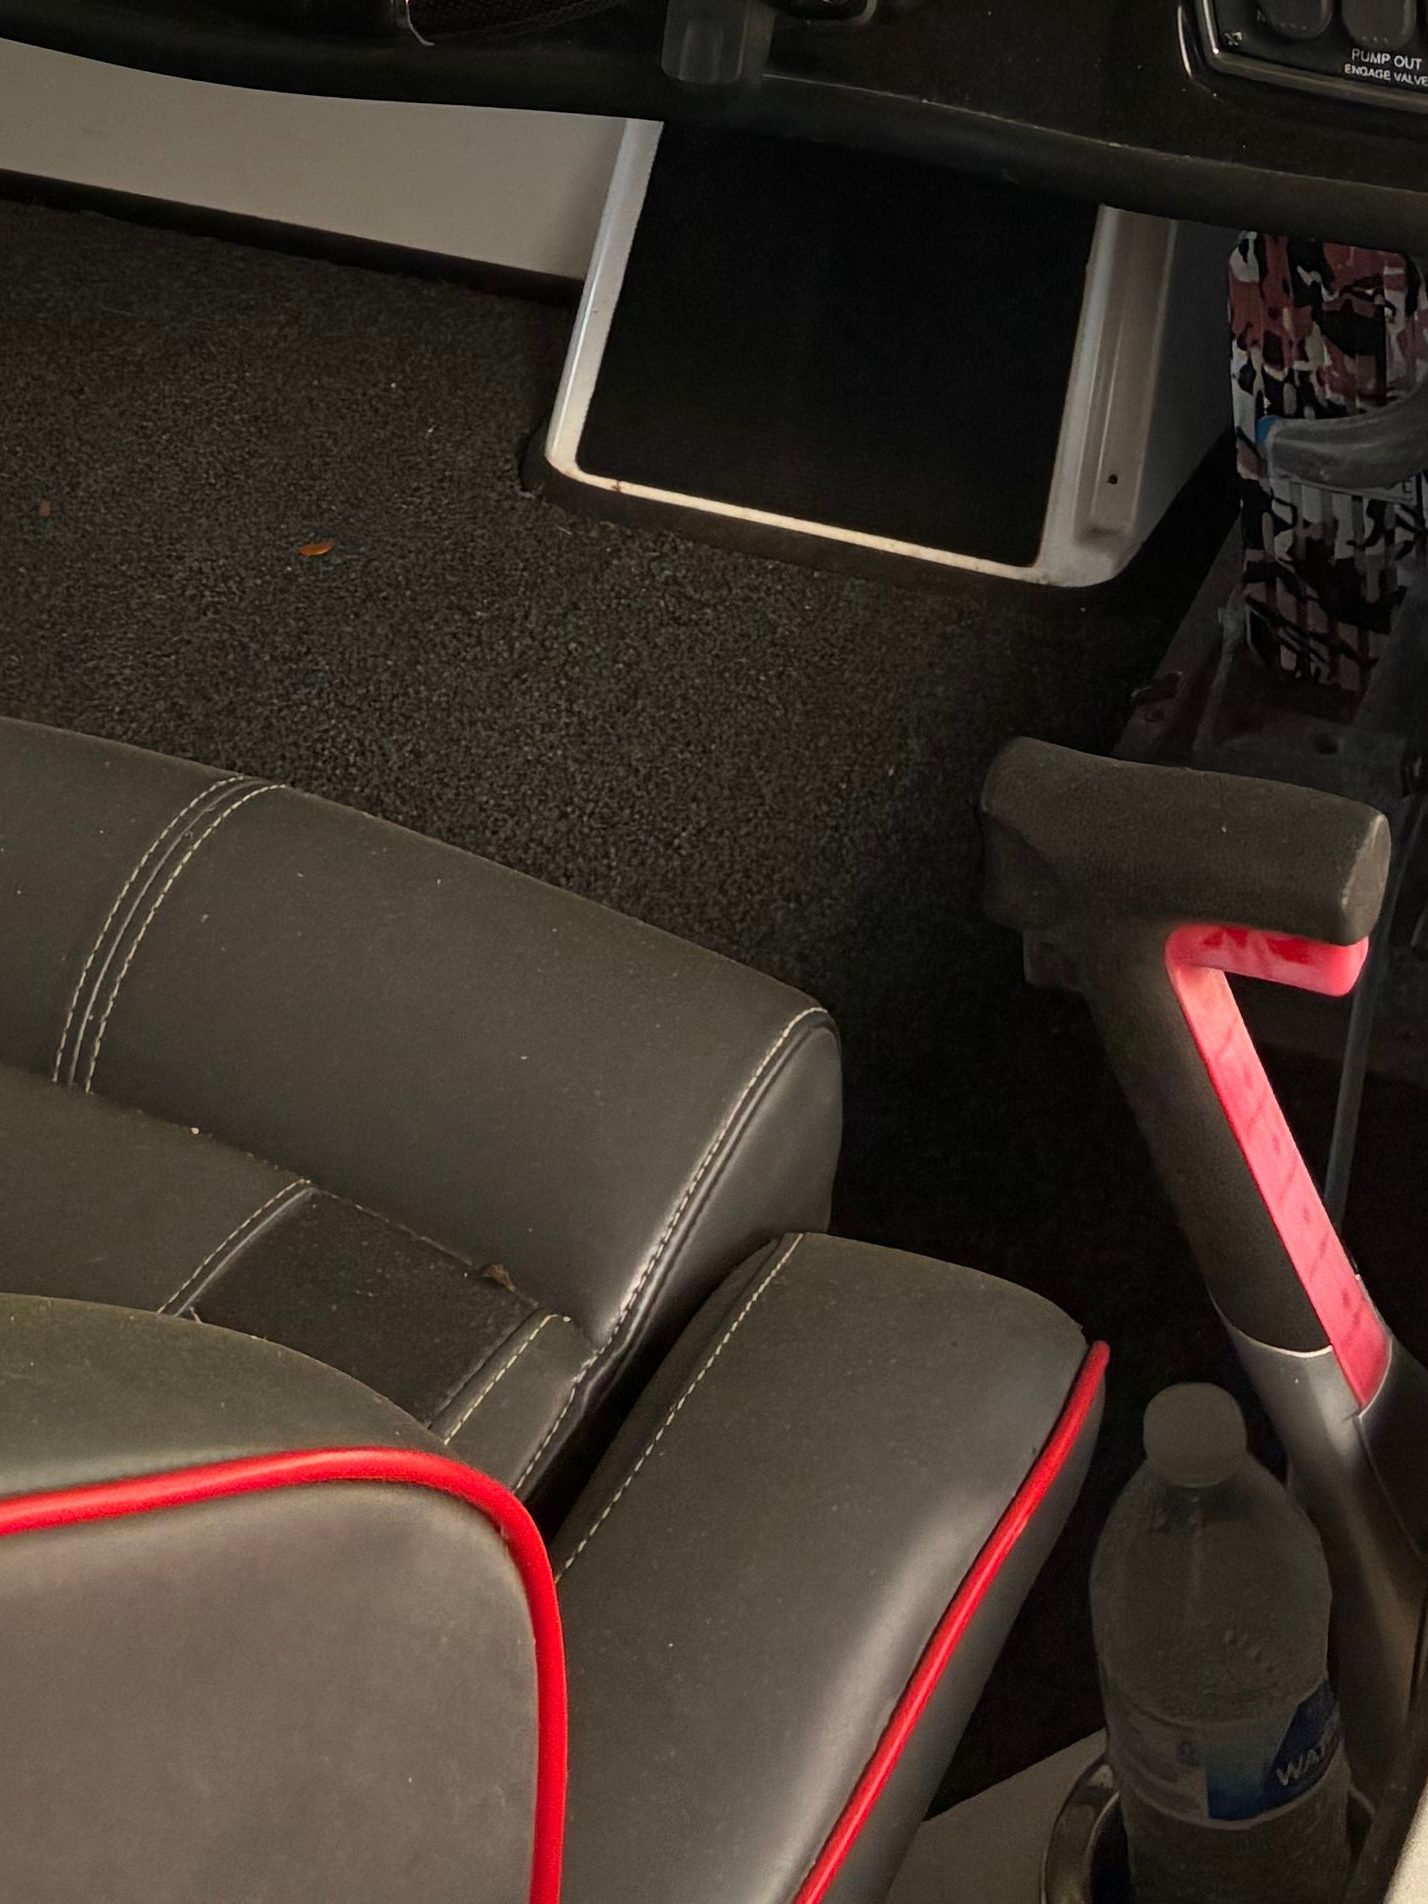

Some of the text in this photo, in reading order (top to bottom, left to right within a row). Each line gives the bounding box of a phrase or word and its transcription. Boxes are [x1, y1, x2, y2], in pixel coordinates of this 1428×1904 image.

[1352, 48, 1423, 71] PUMP OUT
[1344, 64, 1428, 87] ENGAGE VALVE
